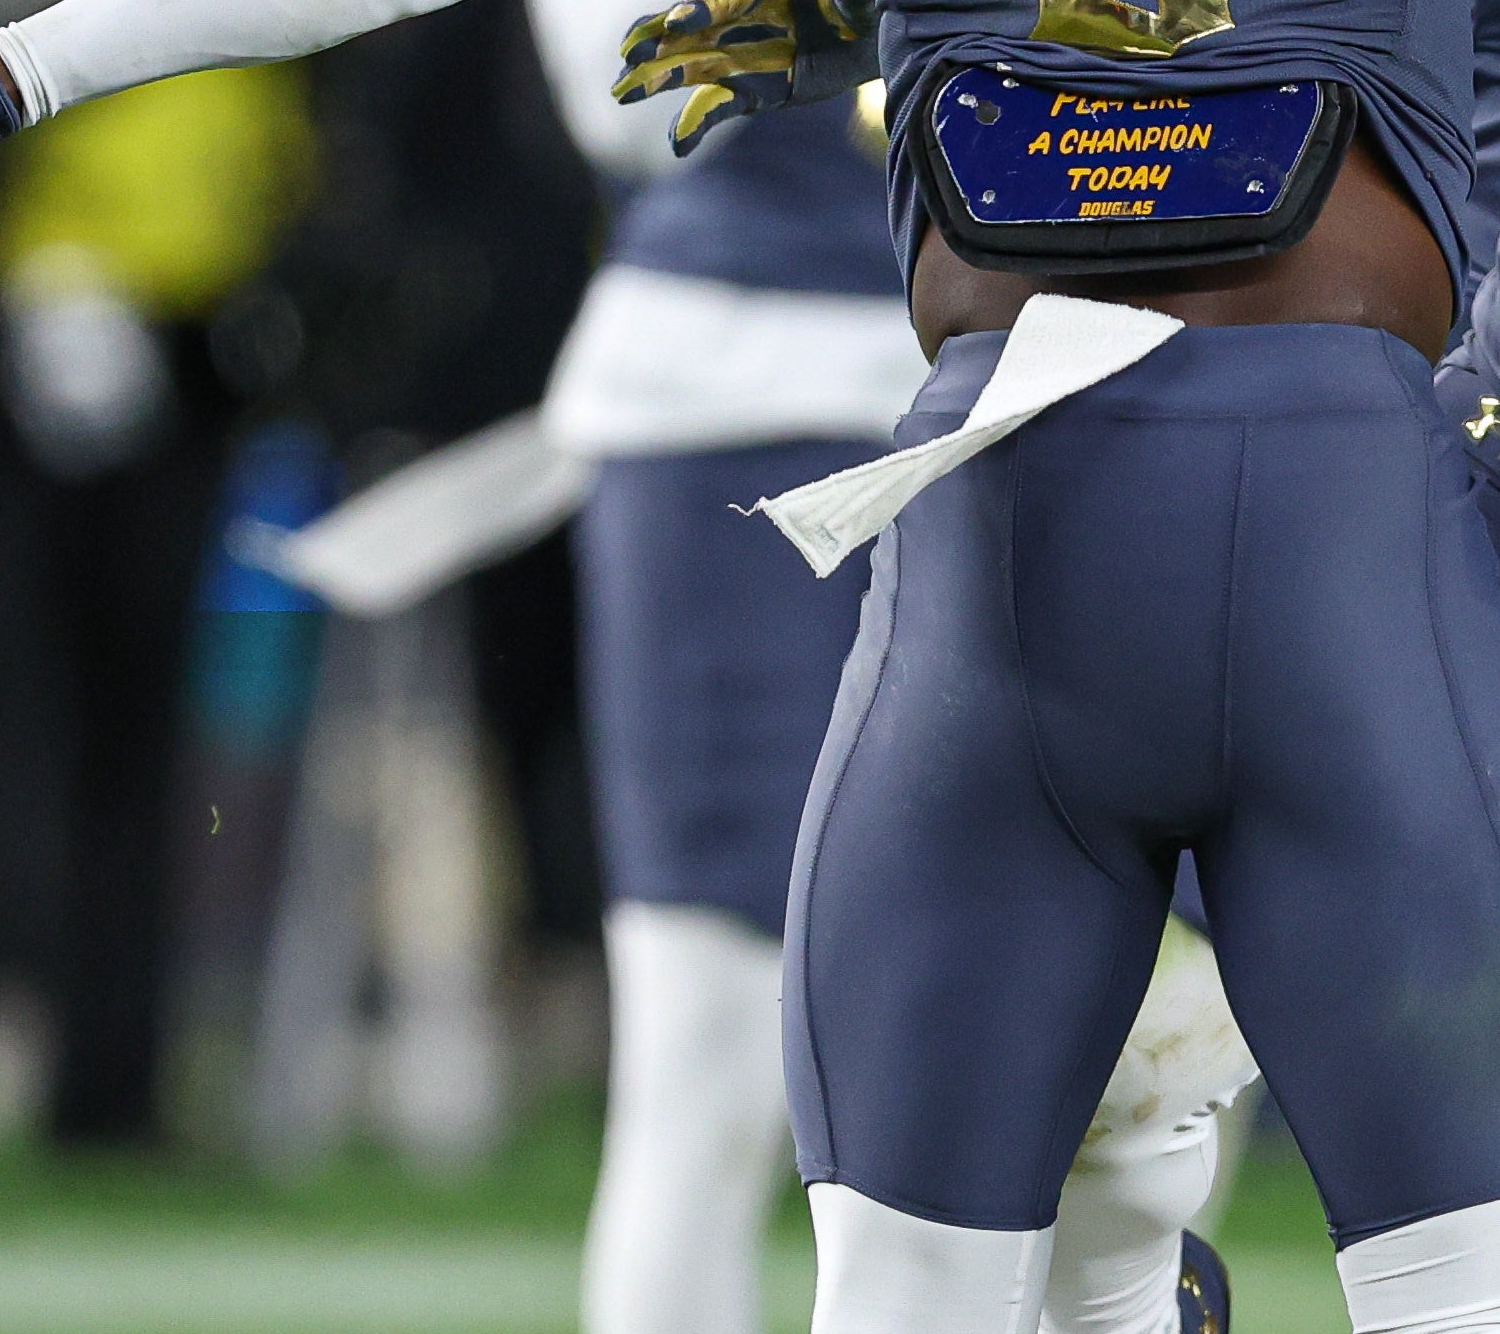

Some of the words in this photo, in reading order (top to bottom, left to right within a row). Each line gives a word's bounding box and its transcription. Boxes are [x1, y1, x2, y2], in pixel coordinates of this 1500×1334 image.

[1028, 131, 1051, 155] A
[1059, 123, 1213, 155] CHAMPION
[1067, 164, 1172, 192] TODAY
[1078, 200, 1156, 217] DOUGLAS
